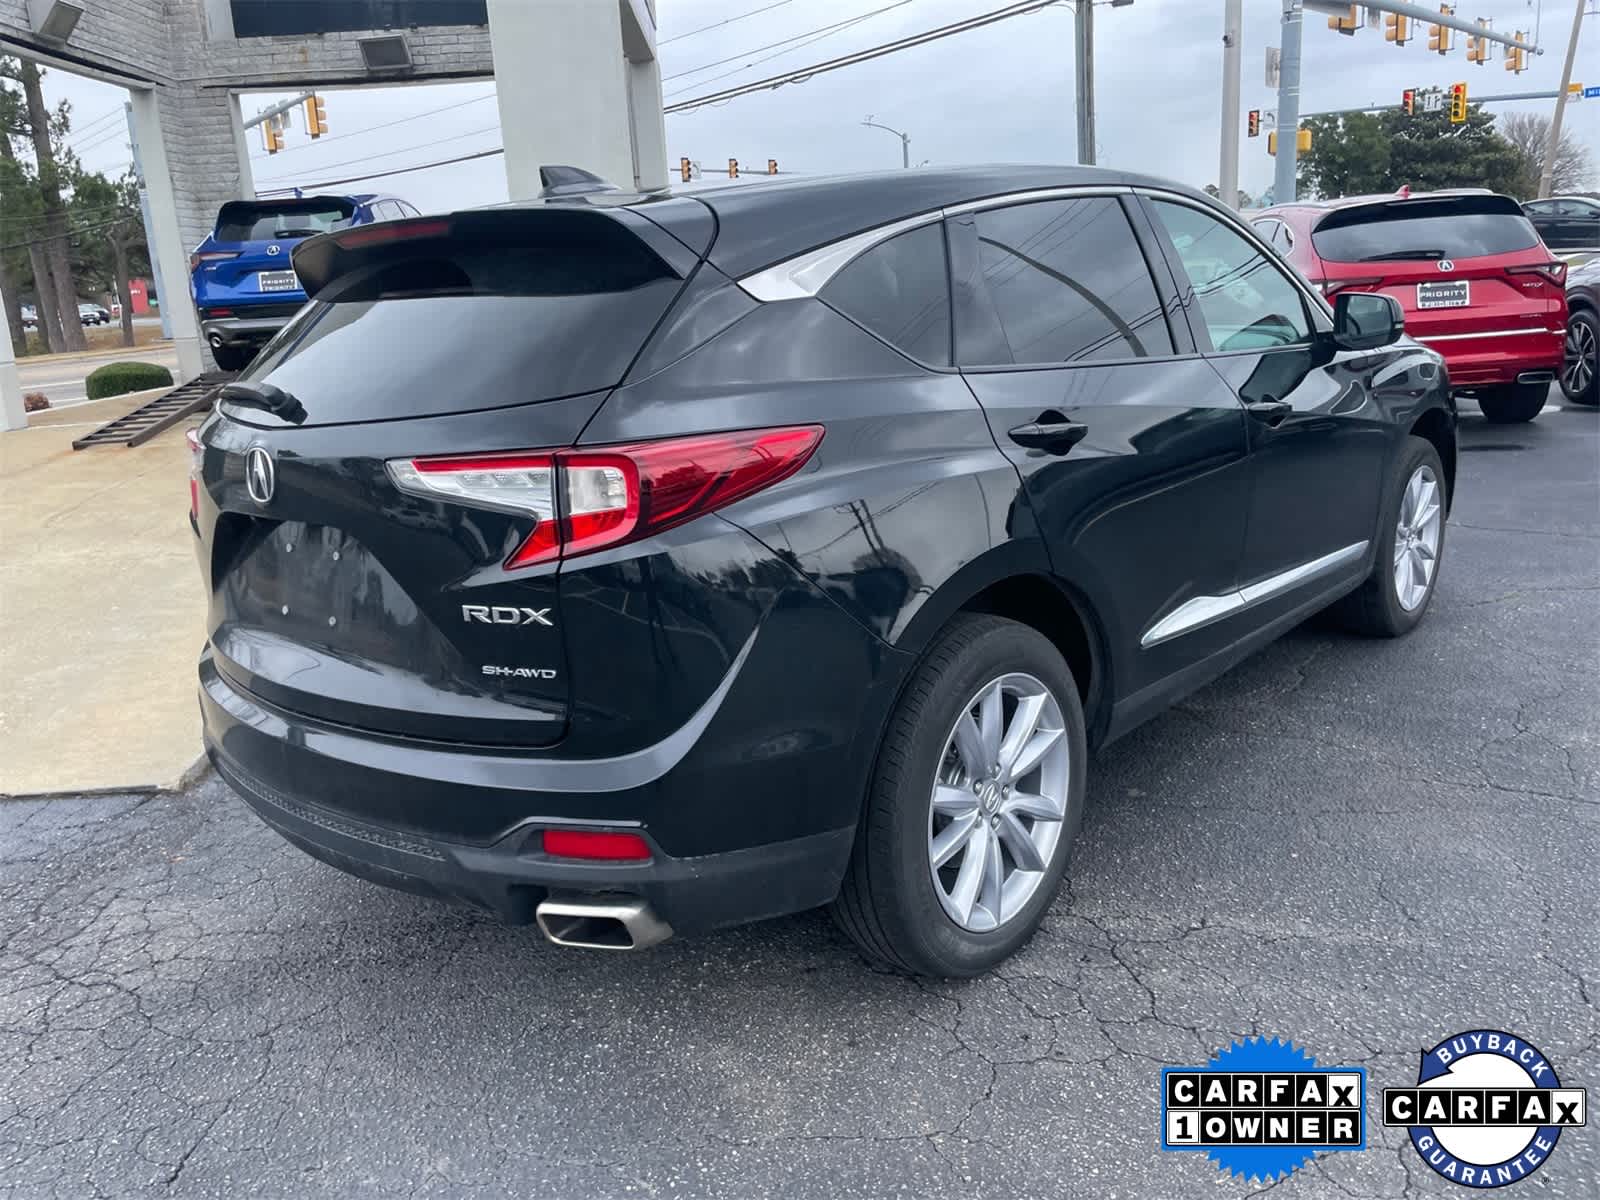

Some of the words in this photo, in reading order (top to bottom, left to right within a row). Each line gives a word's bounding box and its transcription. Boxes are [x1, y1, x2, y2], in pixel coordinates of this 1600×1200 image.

[1420, 289, 1466, 298] PRIORITY
[462, 605, 553, 626] RDX
[482, 665, 557, 679] SH-AWD
